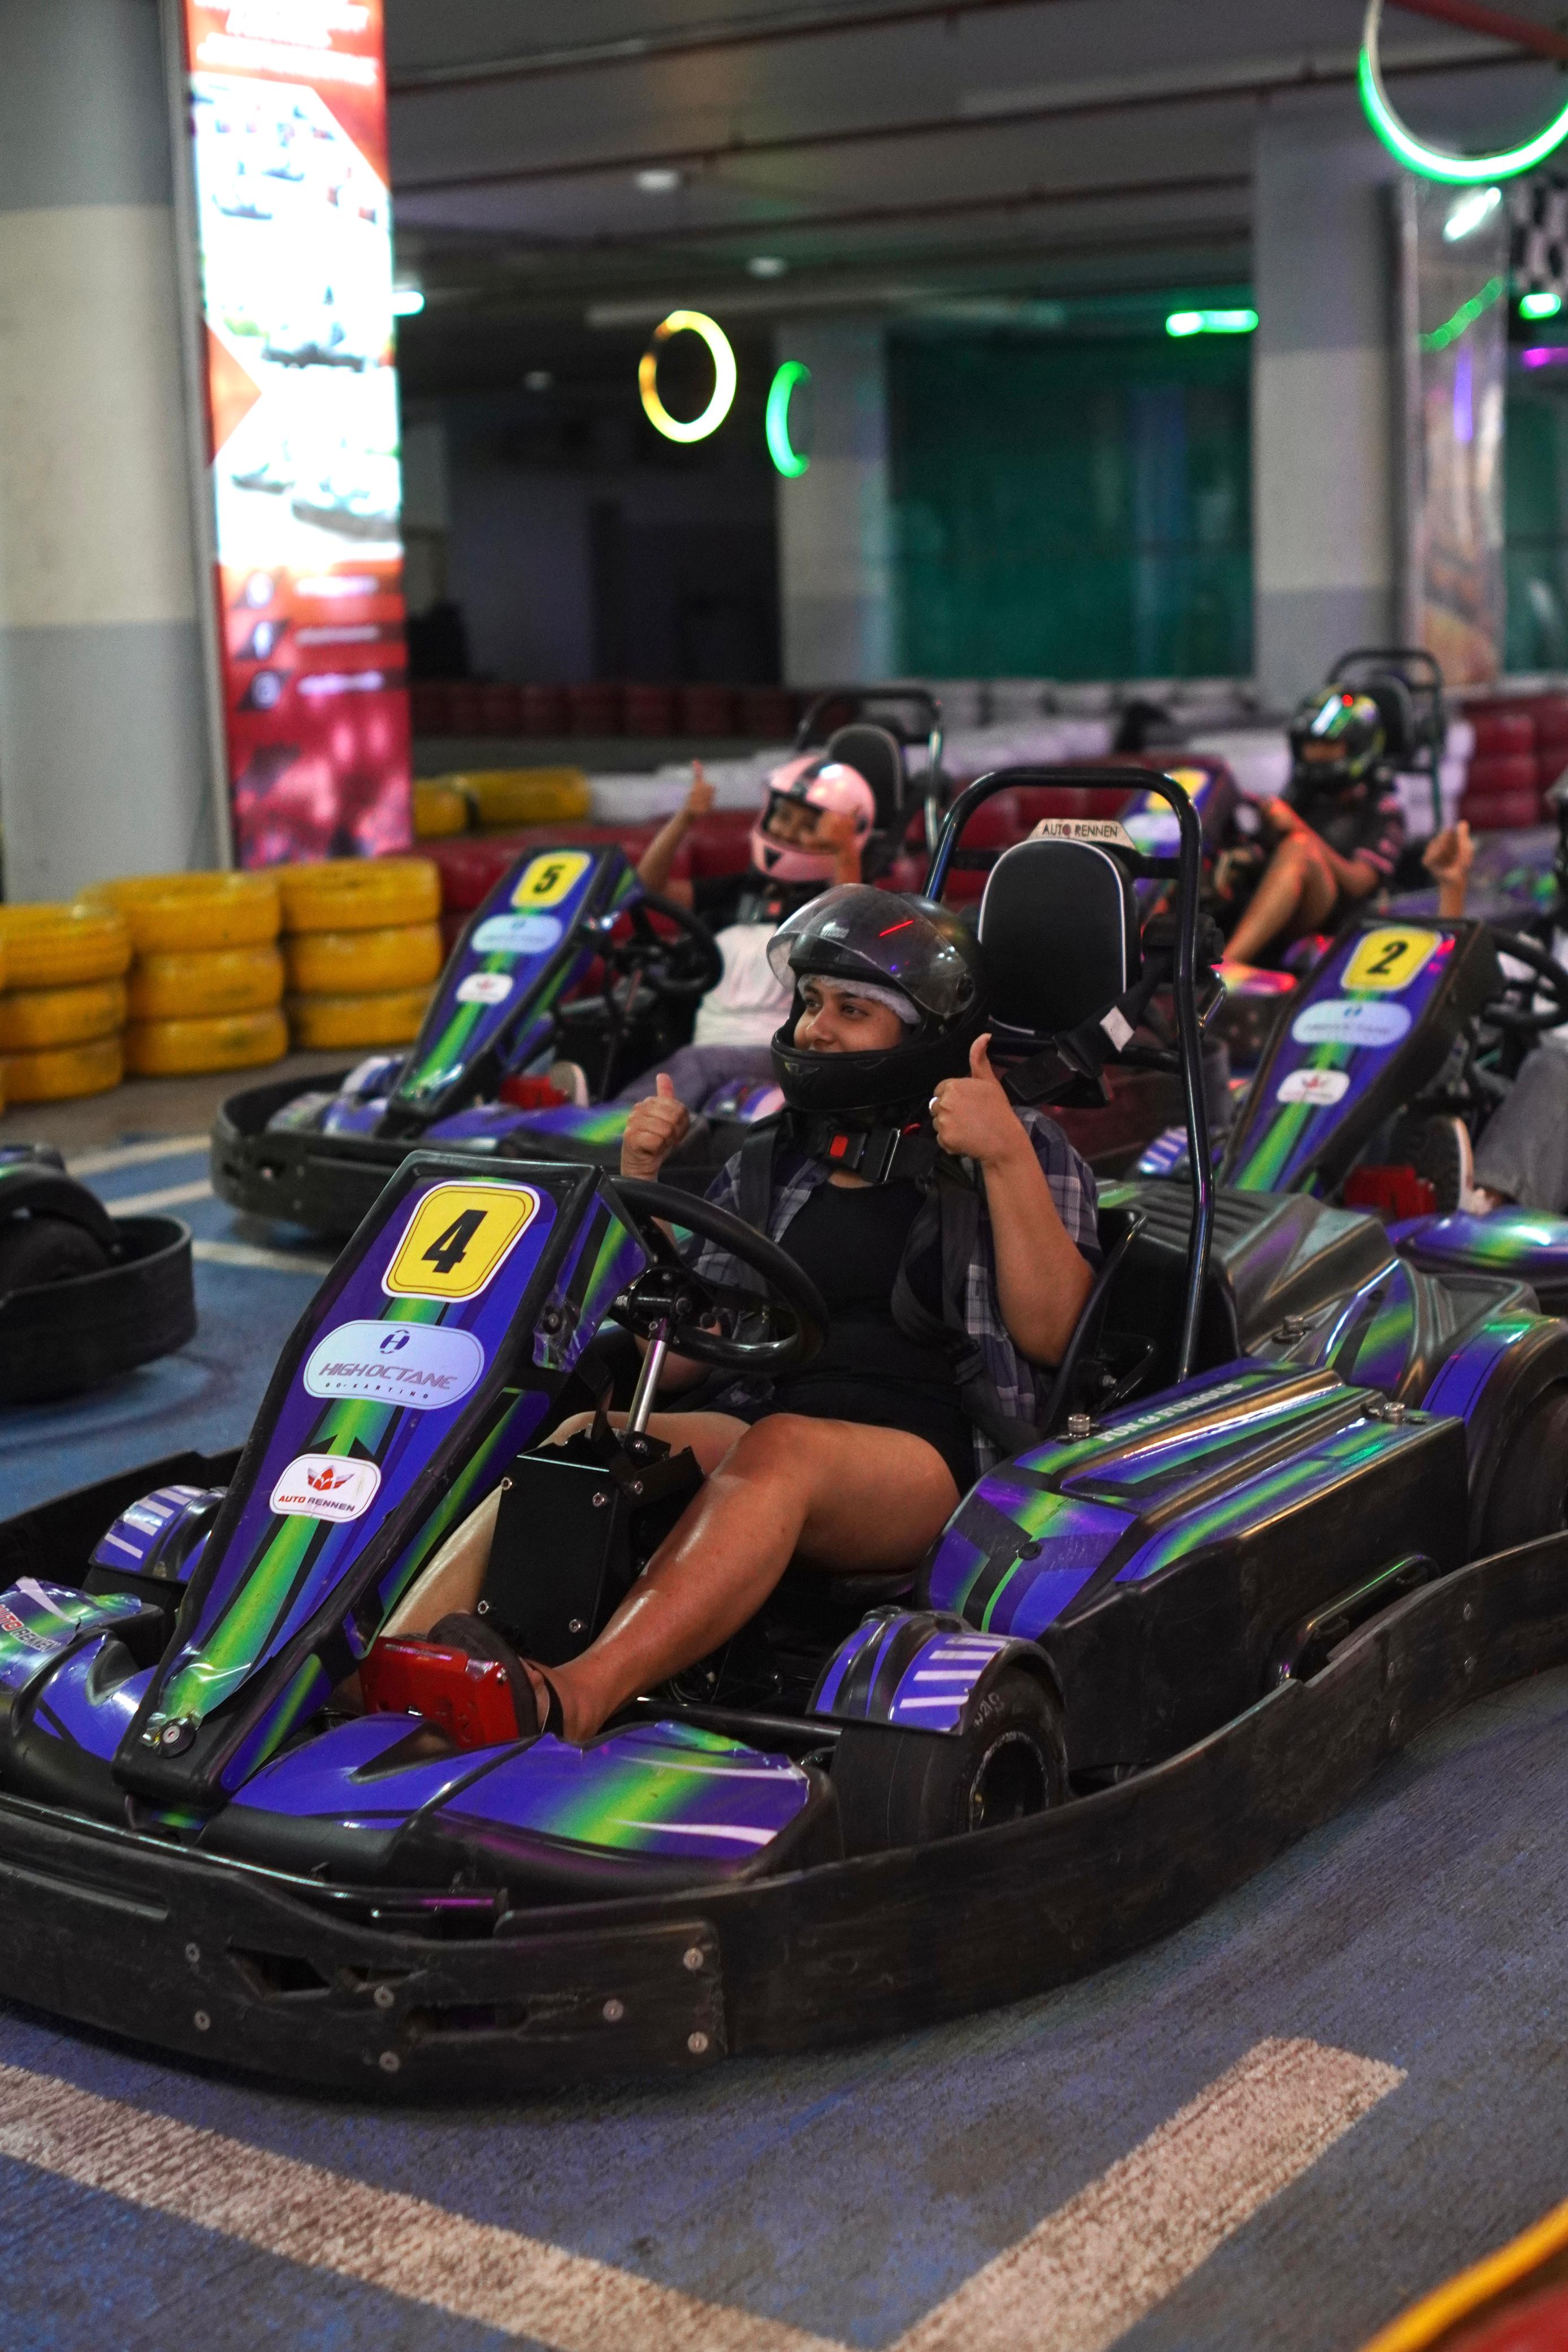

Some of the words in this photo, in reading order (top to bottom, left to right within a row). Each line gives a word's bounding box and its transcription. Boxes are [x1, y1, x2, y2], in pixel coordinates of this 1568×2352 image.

[1042, 823, 1071, 836] AUTO
[1075, 824, 1118, 837] RENNEN
[533, 863, 566, 894] 5
[1367, 941, 1408, 974] 2
[421, 1209, 488, 1274] 4
[1093, 1422, 1145, 1442] FUN
[307, 1497, 356, 1512] RENNEN
